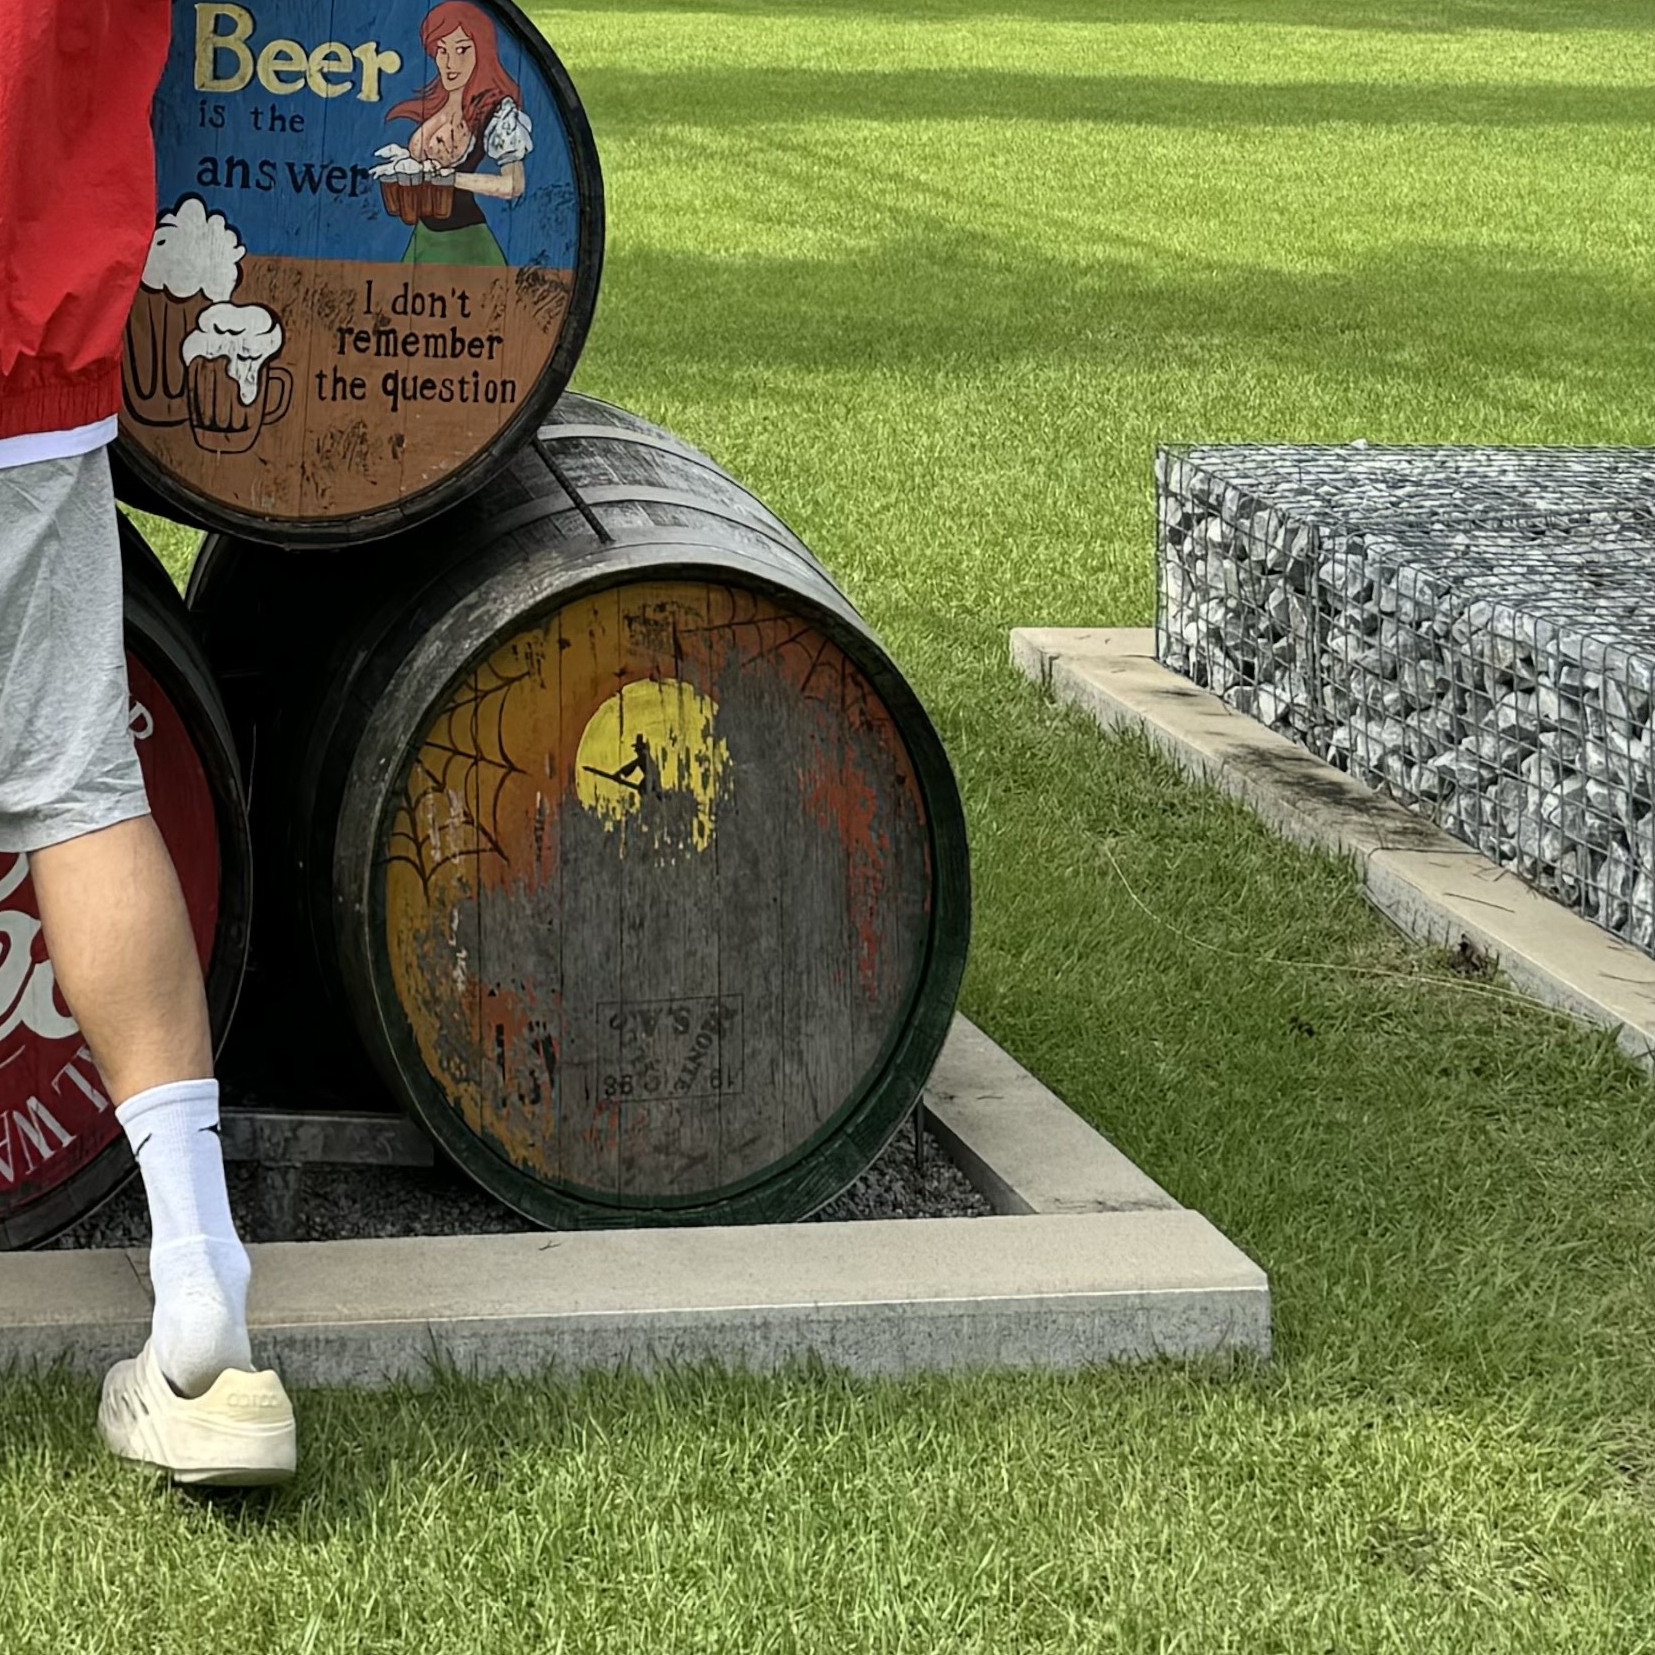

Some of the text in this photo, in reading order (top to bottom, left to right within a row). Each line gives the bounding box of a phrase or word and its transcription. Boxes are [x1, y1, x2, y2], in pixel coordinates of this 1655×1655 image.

[192, 1, 403, 102] Beer
[198, 100, 305, 134] is the
[363, 281, 471, 318] I don't
[336, 324, 504, 360] remember
[315, 368, 517, 413] the question
